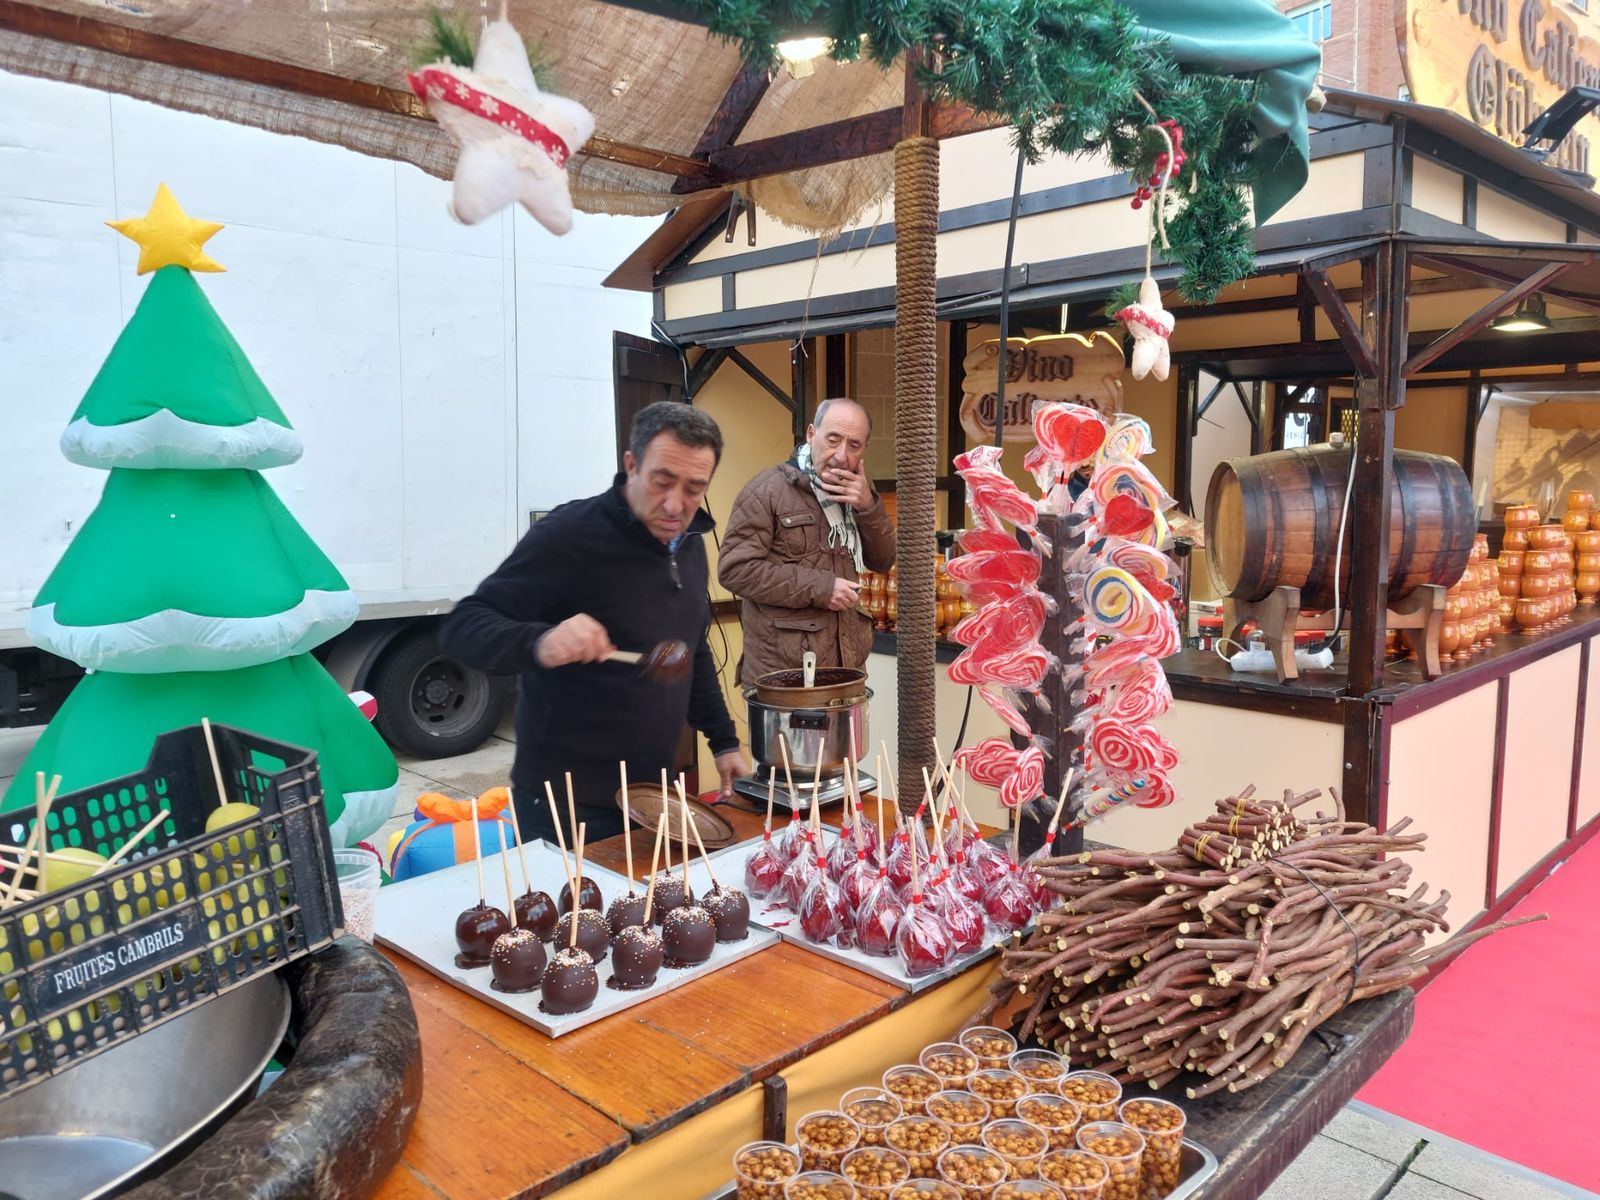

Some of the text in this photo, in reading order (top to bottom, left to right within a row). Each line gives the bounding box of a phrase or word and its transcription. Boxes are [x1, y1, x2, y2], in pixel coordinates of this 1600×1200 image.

[1004, 347, 1074, 383] Vino
[53, 923, 184, 994] FRUITES CAMBRILS
